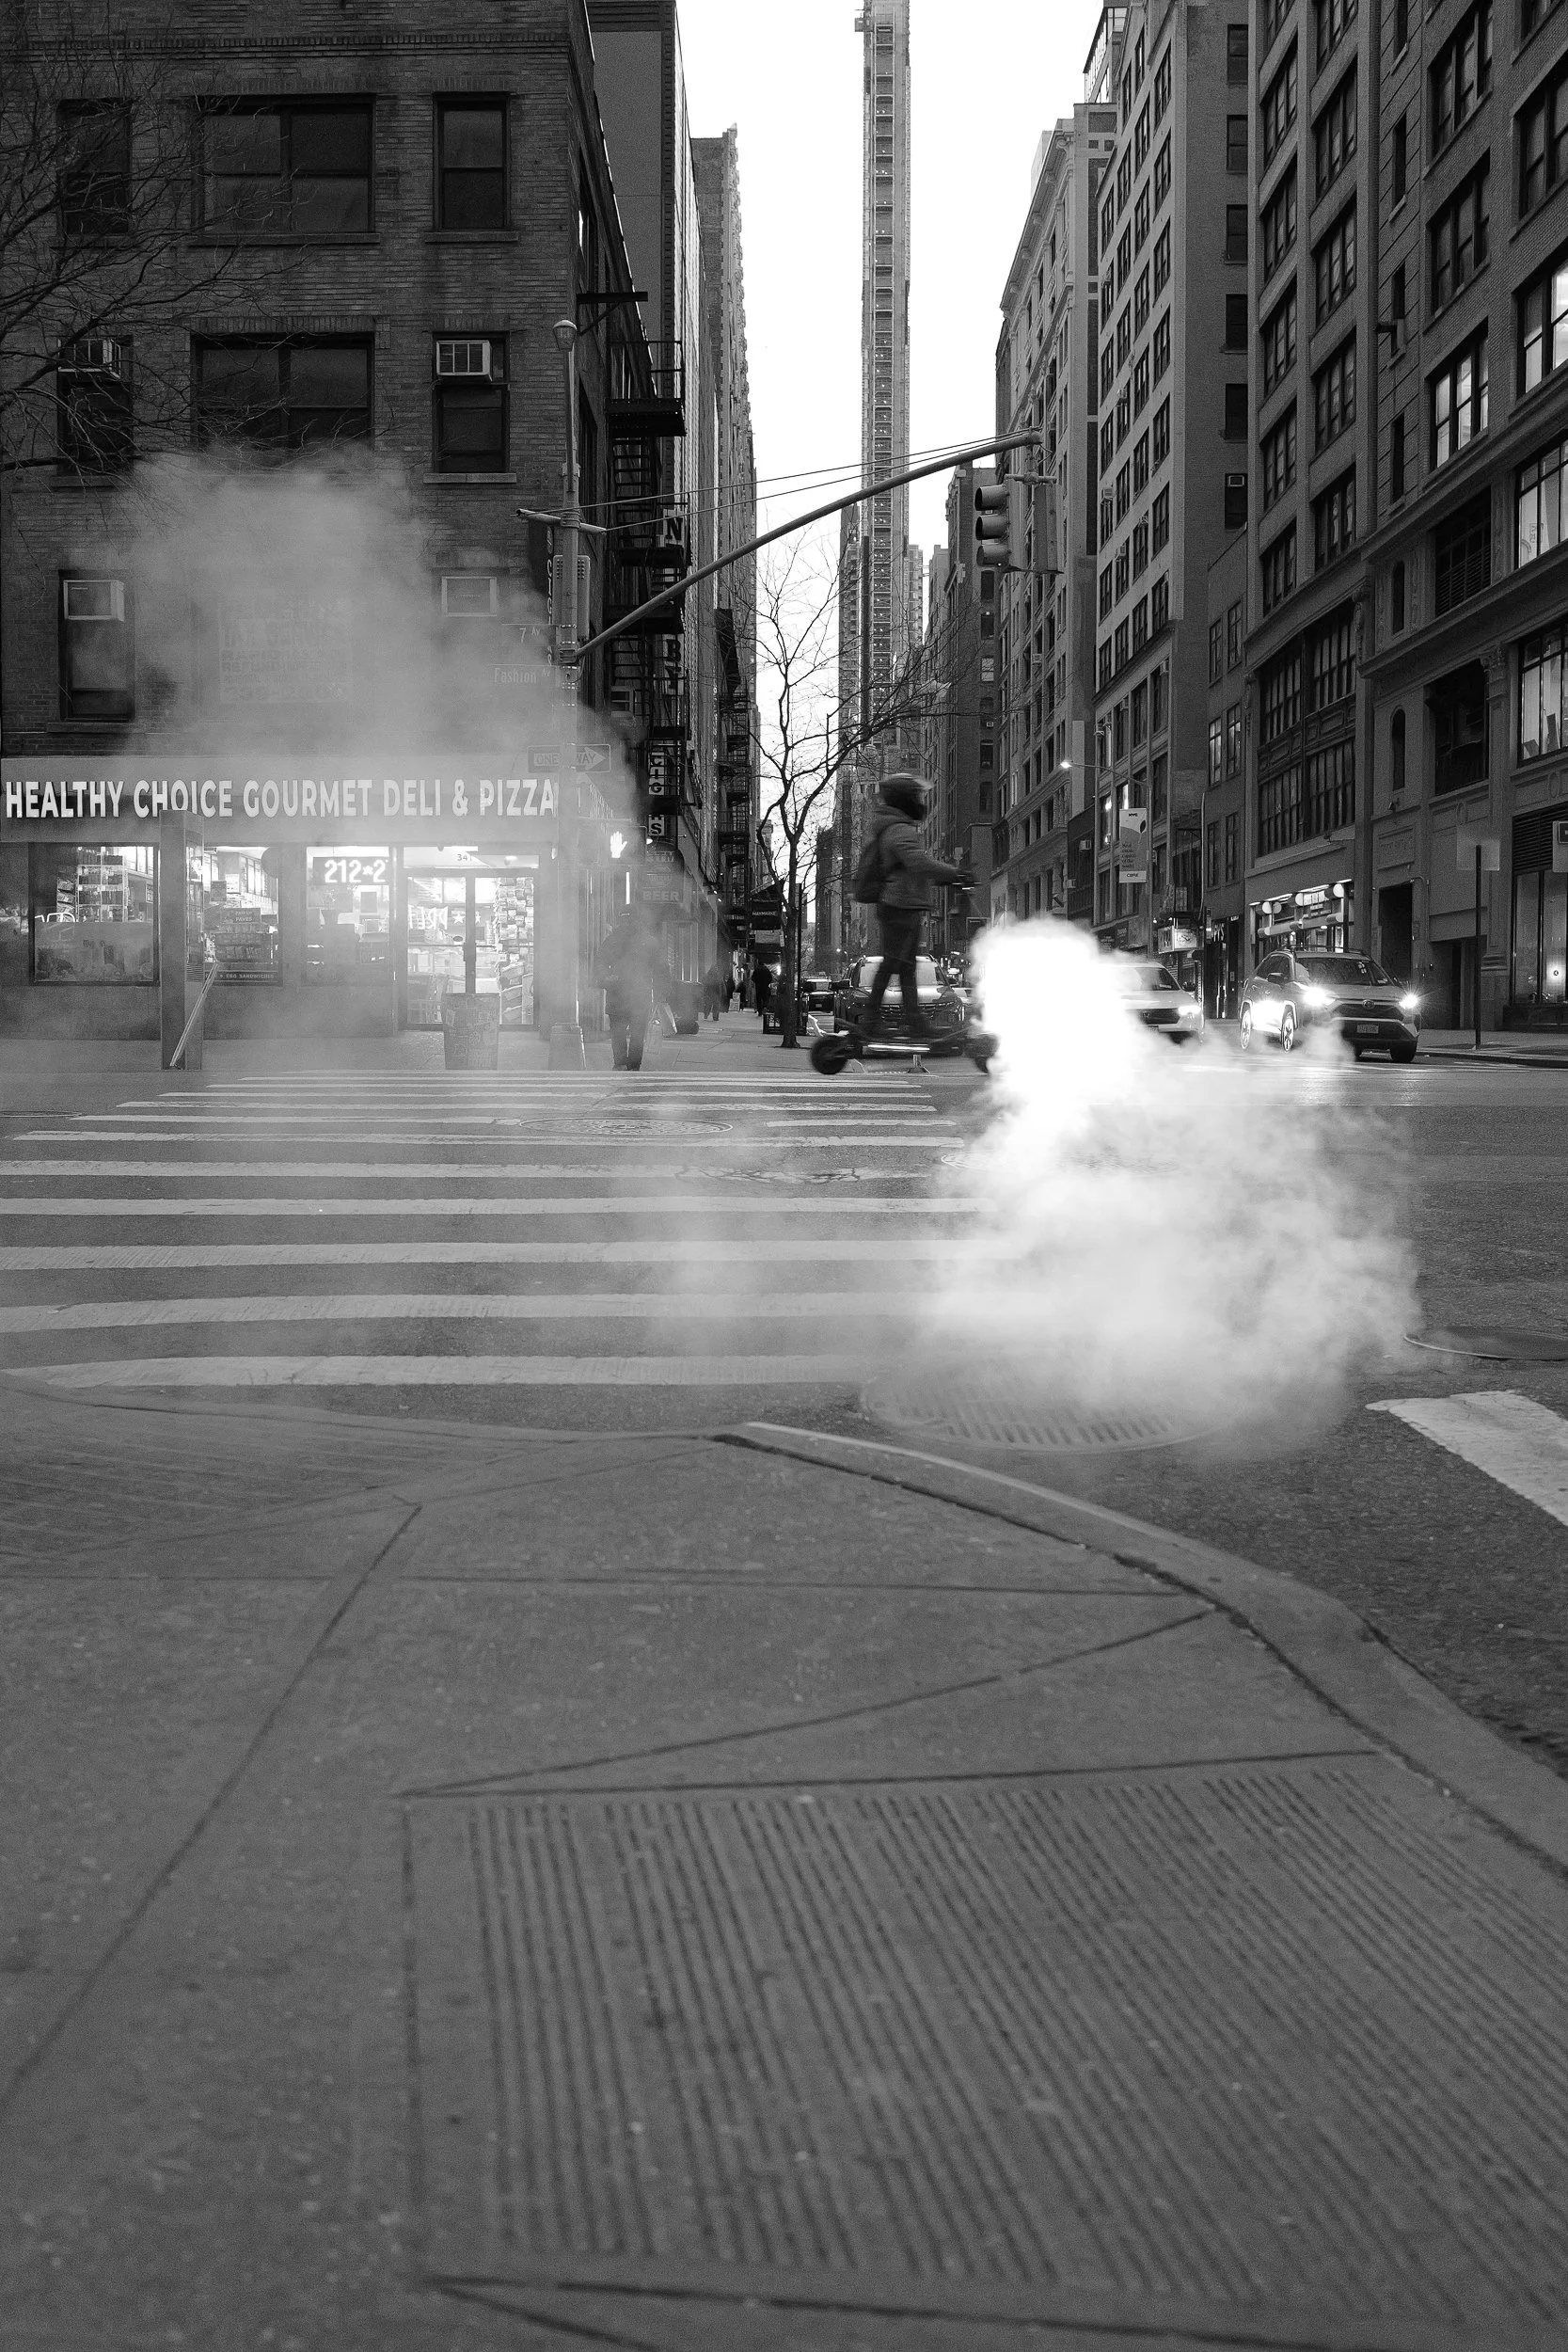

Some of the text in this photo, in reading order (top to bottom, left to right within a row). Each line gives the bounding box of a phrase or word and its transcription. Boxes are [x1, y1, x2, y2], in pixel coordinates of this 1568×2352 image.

[518, 627, 527, 644] 7
[494, 667, 537, 684] Fashion
[536, 754, 559, 765] ONE
[6, 780, 124, 818] HEALTHY
[134, 779, 233, 818] CHOICE
[243, 779, 372, 818] GOURMET
[383, 779, 441, 817] DELI
[451, 779, 468, 817] &
[480, 778, 557, 818] PIZZA
[642, 890, 680, 901] BEER
